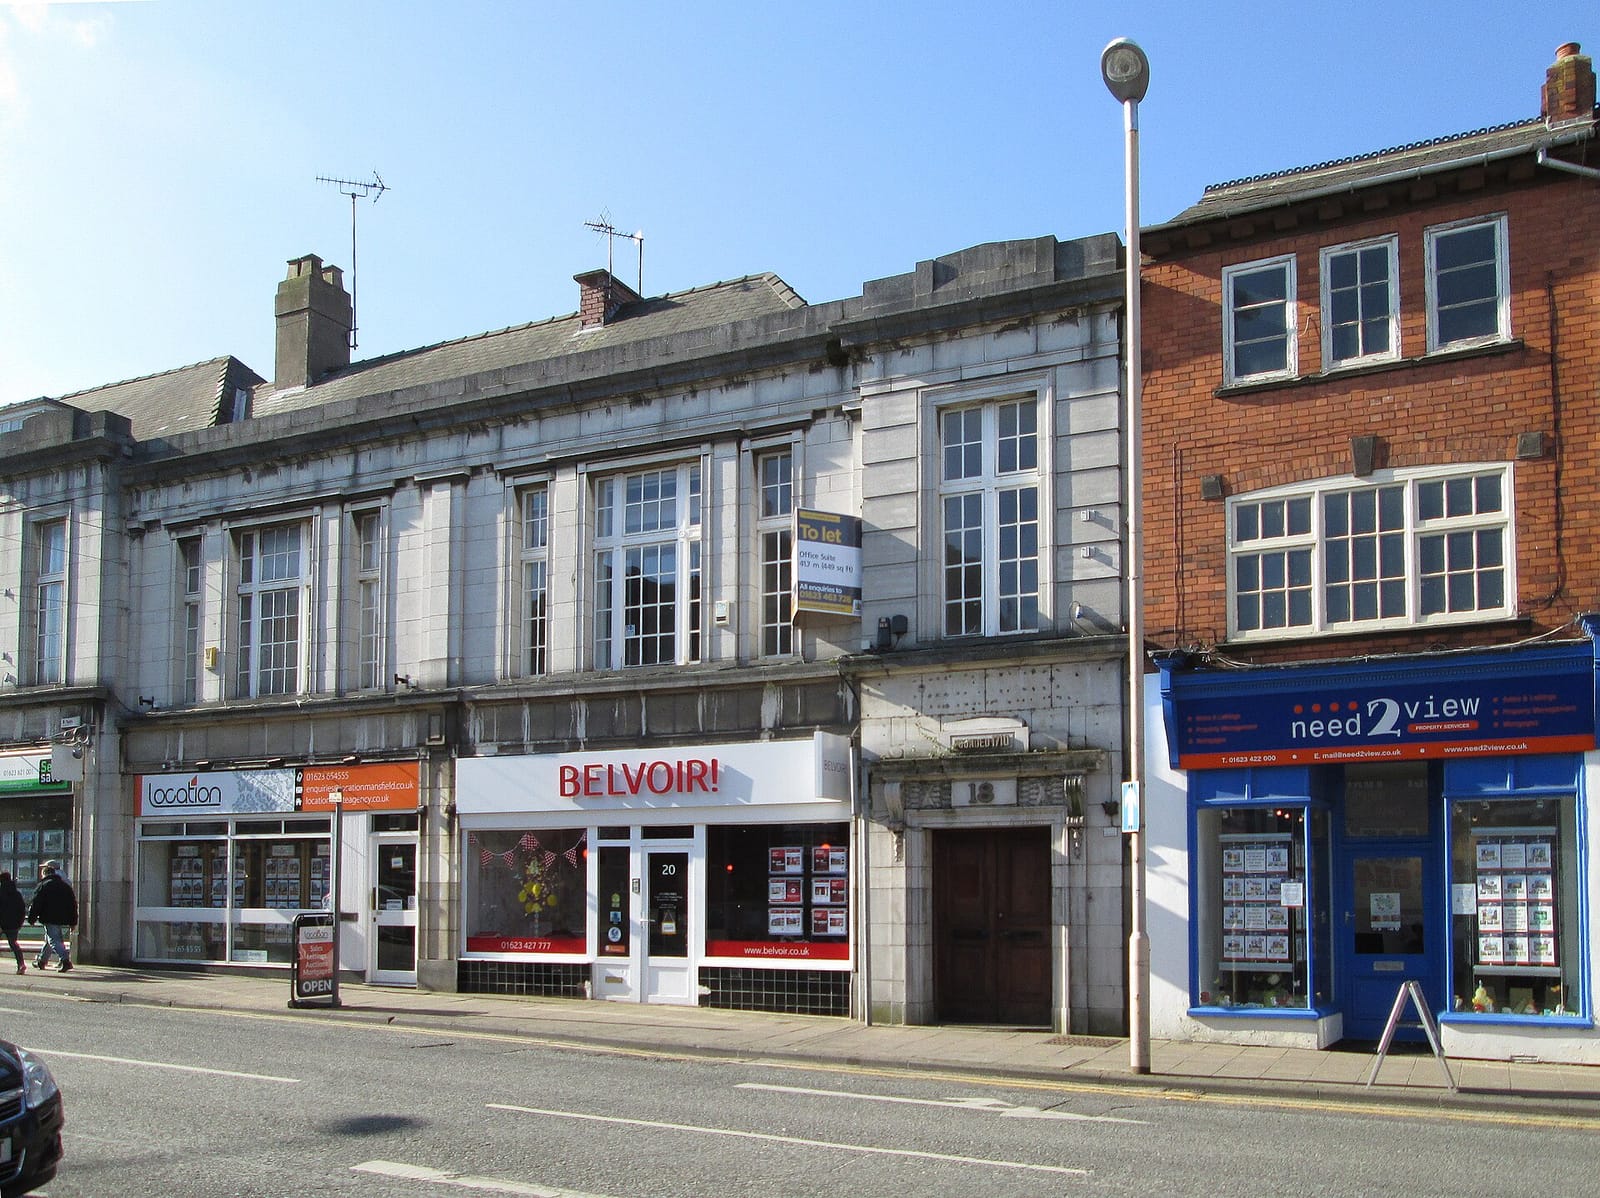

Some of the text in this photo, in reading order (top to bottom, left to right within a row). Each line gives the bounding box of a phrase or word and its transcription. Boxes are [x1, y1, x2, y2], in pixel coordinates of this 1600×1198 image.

[800, 524, 842, 543] To let
[799, 551, 836, 561] Office Suite
[809, 585, 835, 593] enquiries
[1443, 742, 1528, 753] www.need2view.co.uk
[306, 772, 326, 781] 01623
[559, 758, 719, 797] BELVOIR!
[148, 777, 222, 807] location
[967, 783, 995, 803] 18
[662, 864, 676, 876] 20
[501, 941, 551, 950] 01623 427 777
[743, 946, 810, 956] www.belvoir.co.uk
[302, 980, 332, 993] OPEN
